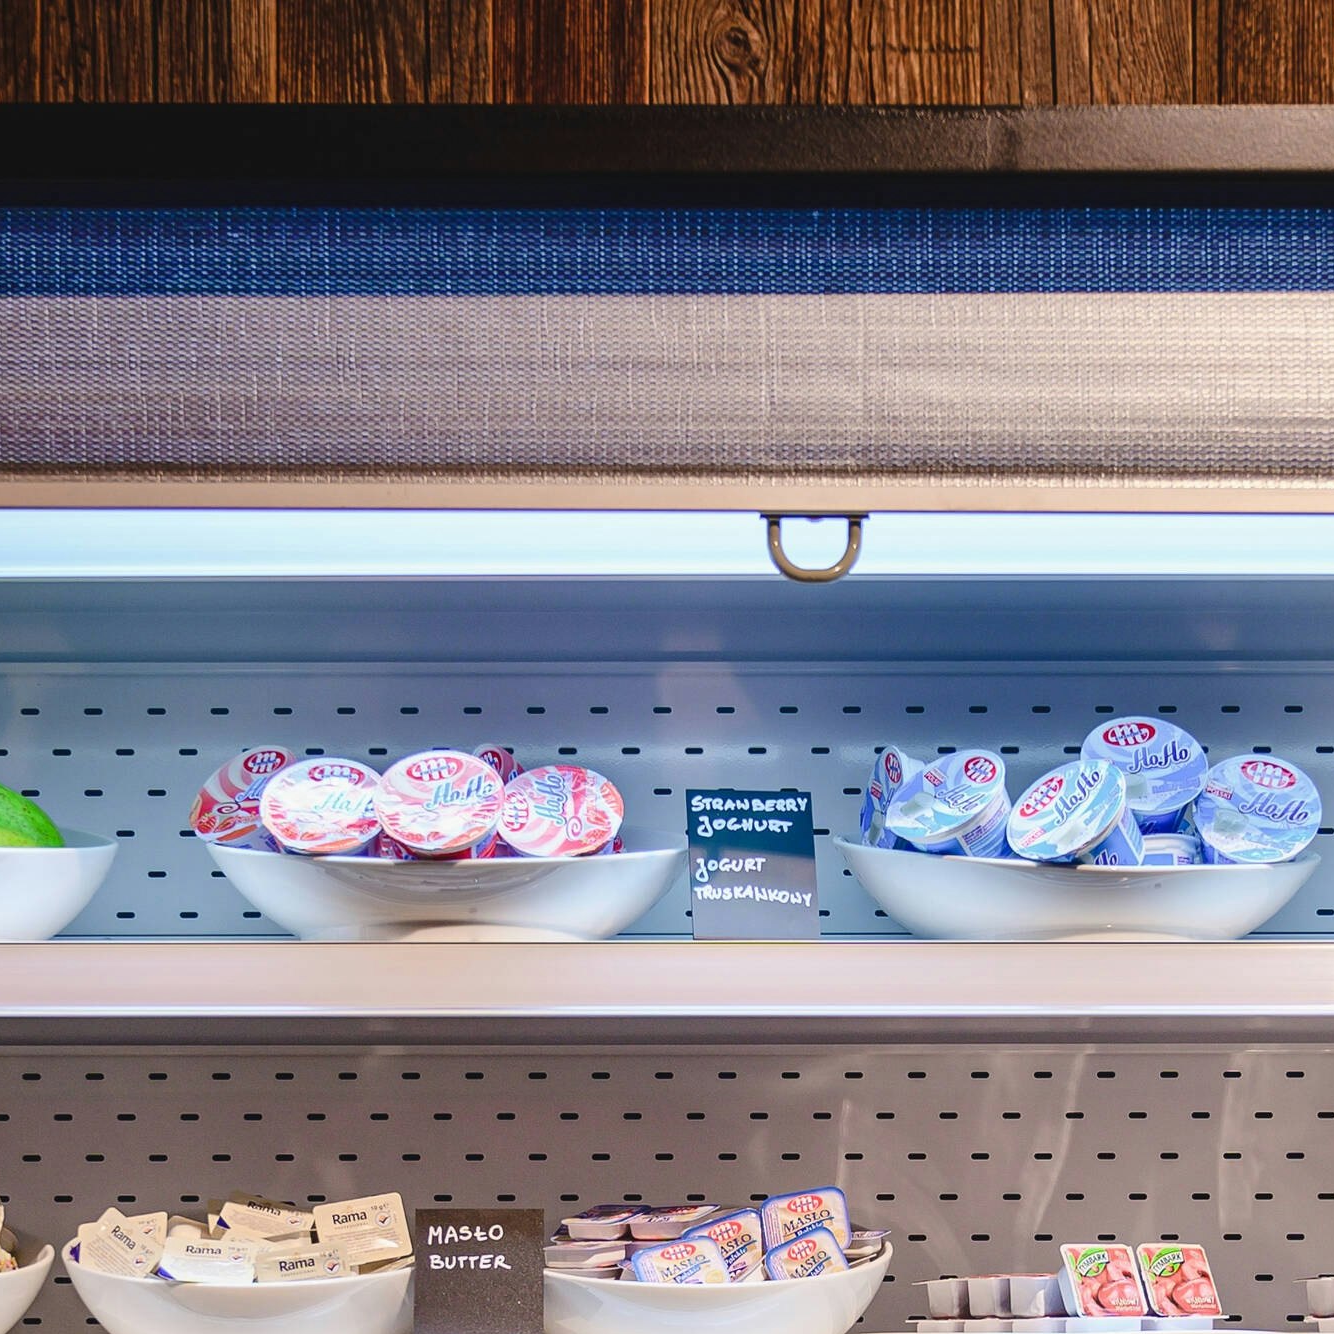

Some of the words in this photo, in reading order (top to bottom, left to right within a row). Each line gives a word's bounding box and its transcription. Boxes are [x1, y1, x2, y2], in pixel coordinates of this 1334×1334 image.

[691, 795, 808, 812] STRAWBERRY
[695, 857, 766, 882] JOGURT
[247, 1201, 281, 1216] Rama
[331, 1210, 367, 1225] Rama
[111, 1225, 137, 1250] Rama
[427, 1225, 504, 1245] MASŁO
[186, 1245, 222, 1255] Rama
[720, 1233, 752, 1257] ASŁO
[279, 1258, 315, 1272] Rama
[429, 1254, 512, 1270] BUTTER
